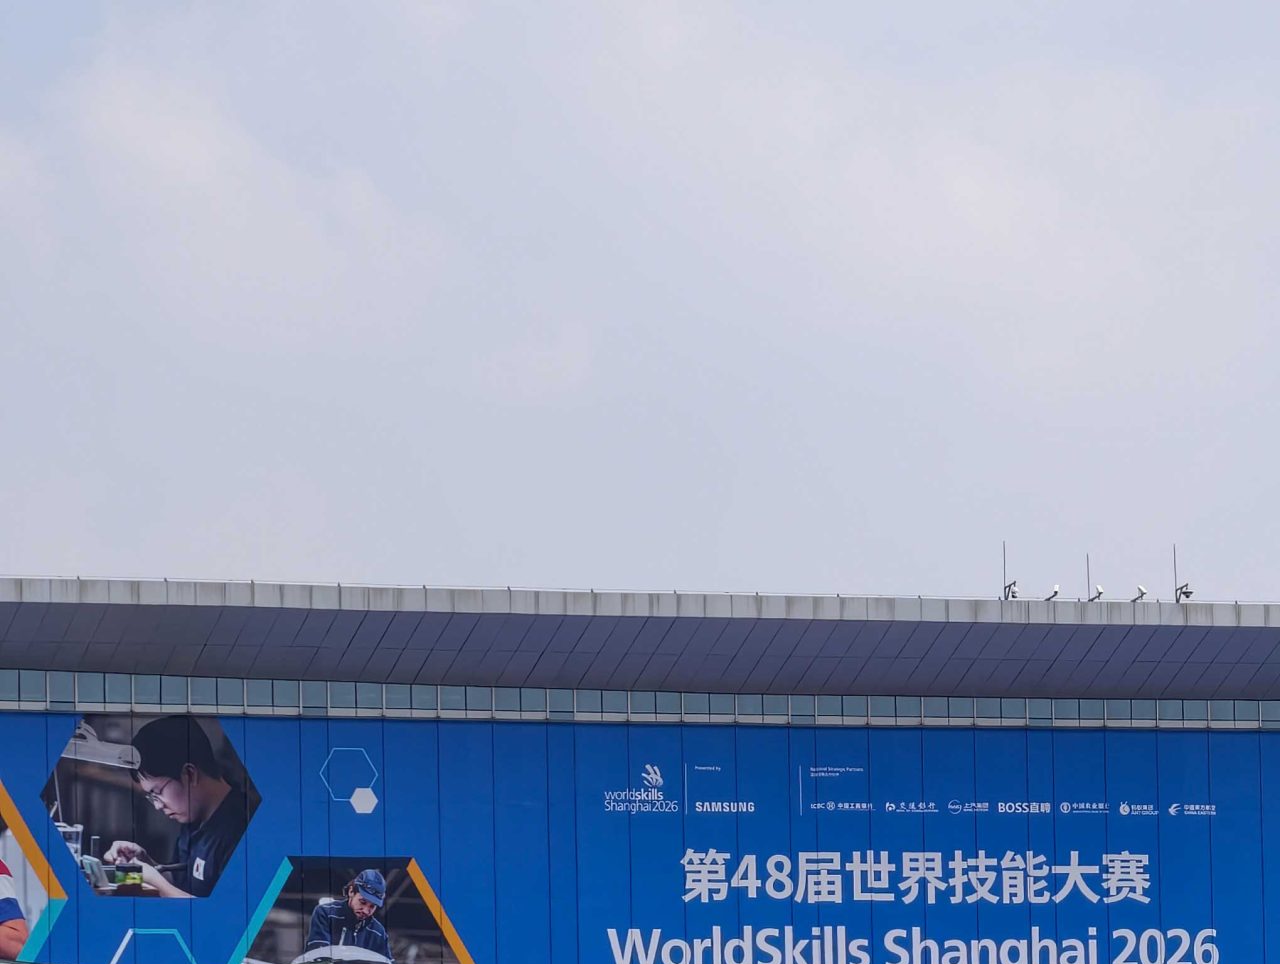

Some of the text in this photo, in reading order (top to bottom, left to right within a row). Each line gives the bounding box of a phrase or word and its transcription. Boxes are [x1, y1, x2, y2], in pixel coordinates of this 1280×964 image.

[604, 788, 664, 801] worldskills
[695, 801, 756, 812] SAMSUNG
[681, 848, 1152, 905] 第48届世界技能大赛
